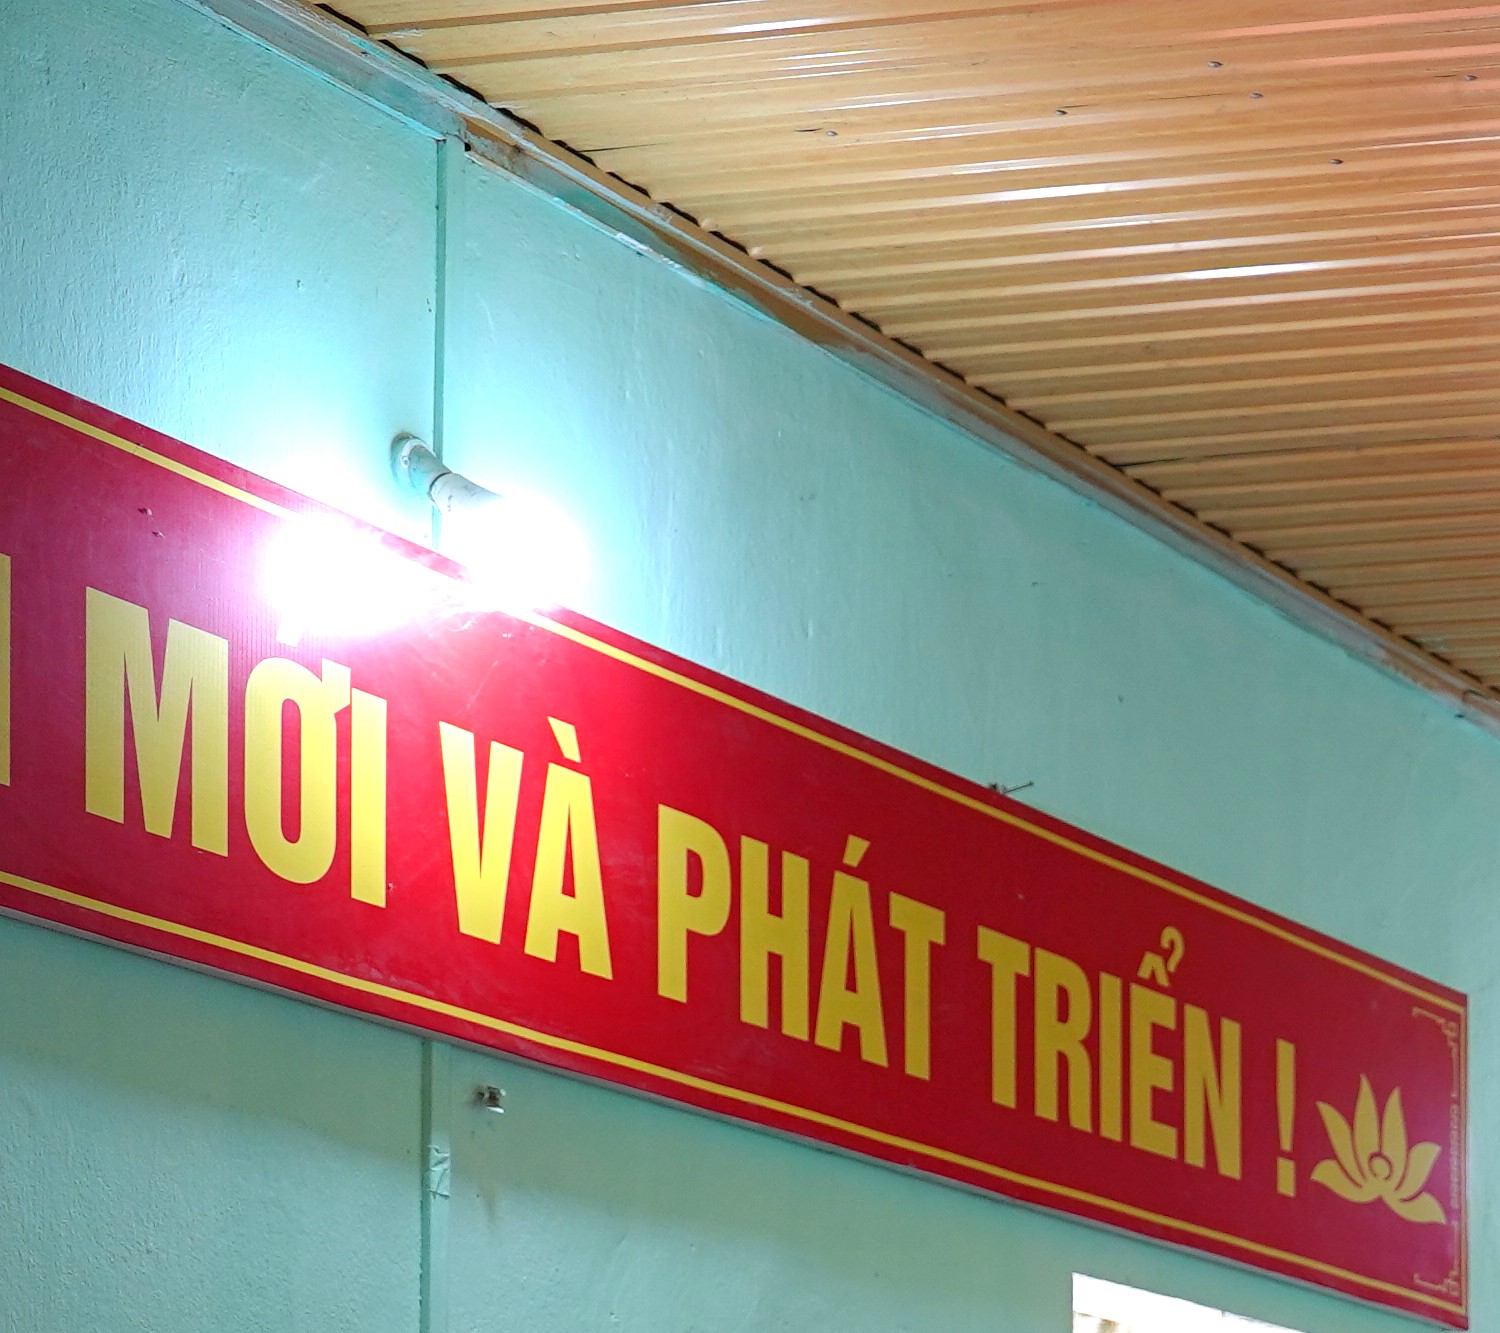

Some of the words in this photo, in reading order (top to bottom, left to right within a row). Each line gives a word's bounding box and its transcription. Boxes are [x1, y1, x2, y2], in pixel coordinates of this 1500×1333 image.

[439, 717, 614, 981] VÀ
[656, 803, 946, 1082] PHÁT
[976, 926, 1242, 1180] TRIỂN
[1276, 1039, 1295, 1197] !
